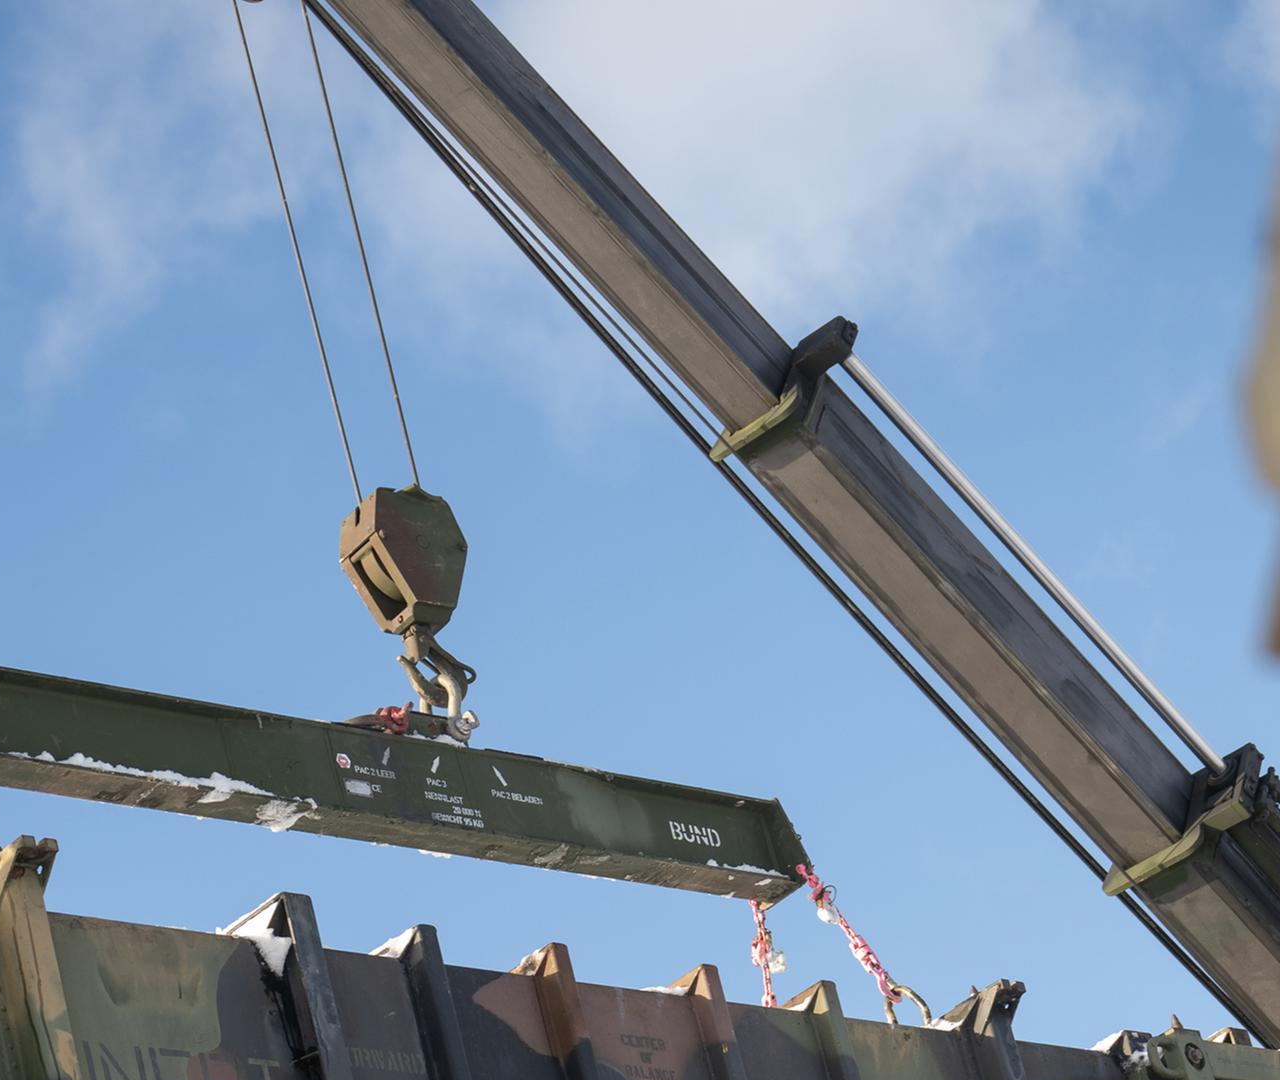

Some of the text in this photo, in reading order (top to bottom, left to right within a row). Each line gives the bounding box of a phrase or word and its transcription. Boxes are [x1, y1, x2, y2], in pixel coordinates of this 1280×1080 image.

[354, 765, 397, 780] PAC 2 LEER
[371, 784, 383, 793] CE
[426, 777, 441, 787] PAC
[424, 790, 464, 805] NENNLAST
[491, 788, 544, 805] PAC 2 BELADEN
[431, 812, 463, 825] GEWICHT
[472, 819, 485, 829] KG
[668, 820, 721, 848] BUND
[620, 1033, 666, 1051] CENTER
